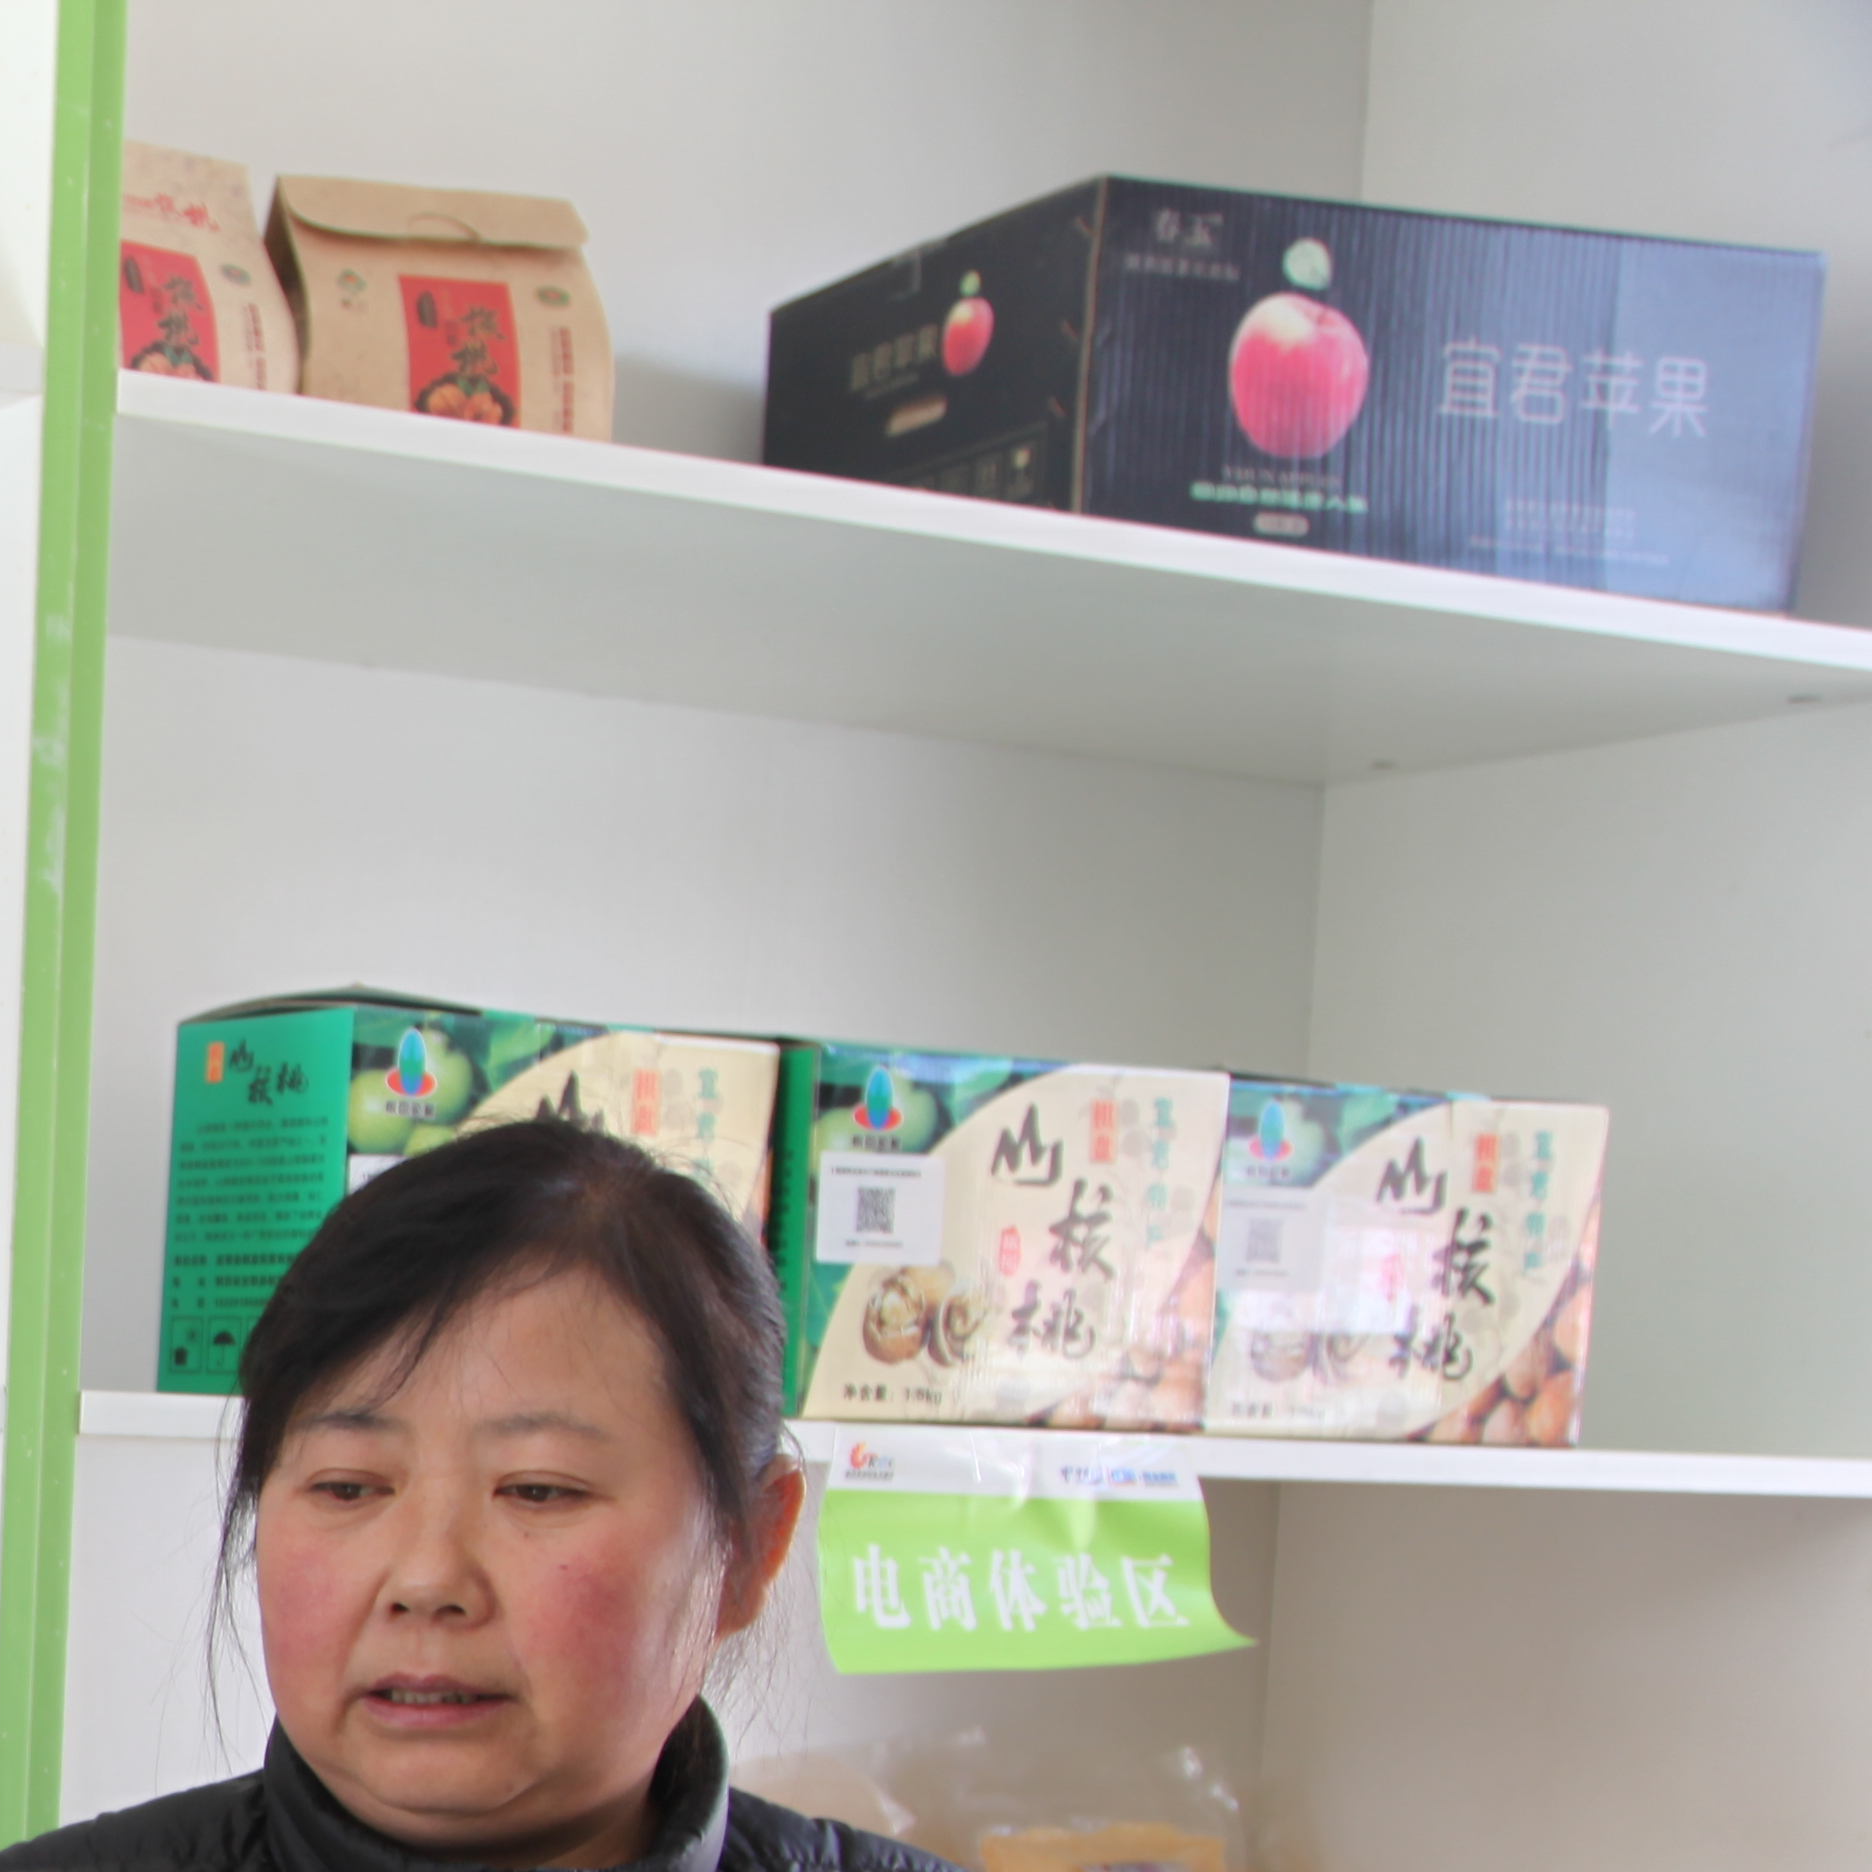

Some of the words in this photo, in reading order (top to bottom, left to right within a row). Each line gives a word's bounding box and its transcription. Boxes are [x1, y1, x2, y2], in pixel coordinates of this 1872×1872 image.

[1438, 337, 1709, 438] 宜君苹果
[853, 1543, 1191, 1632] 电商体验区
